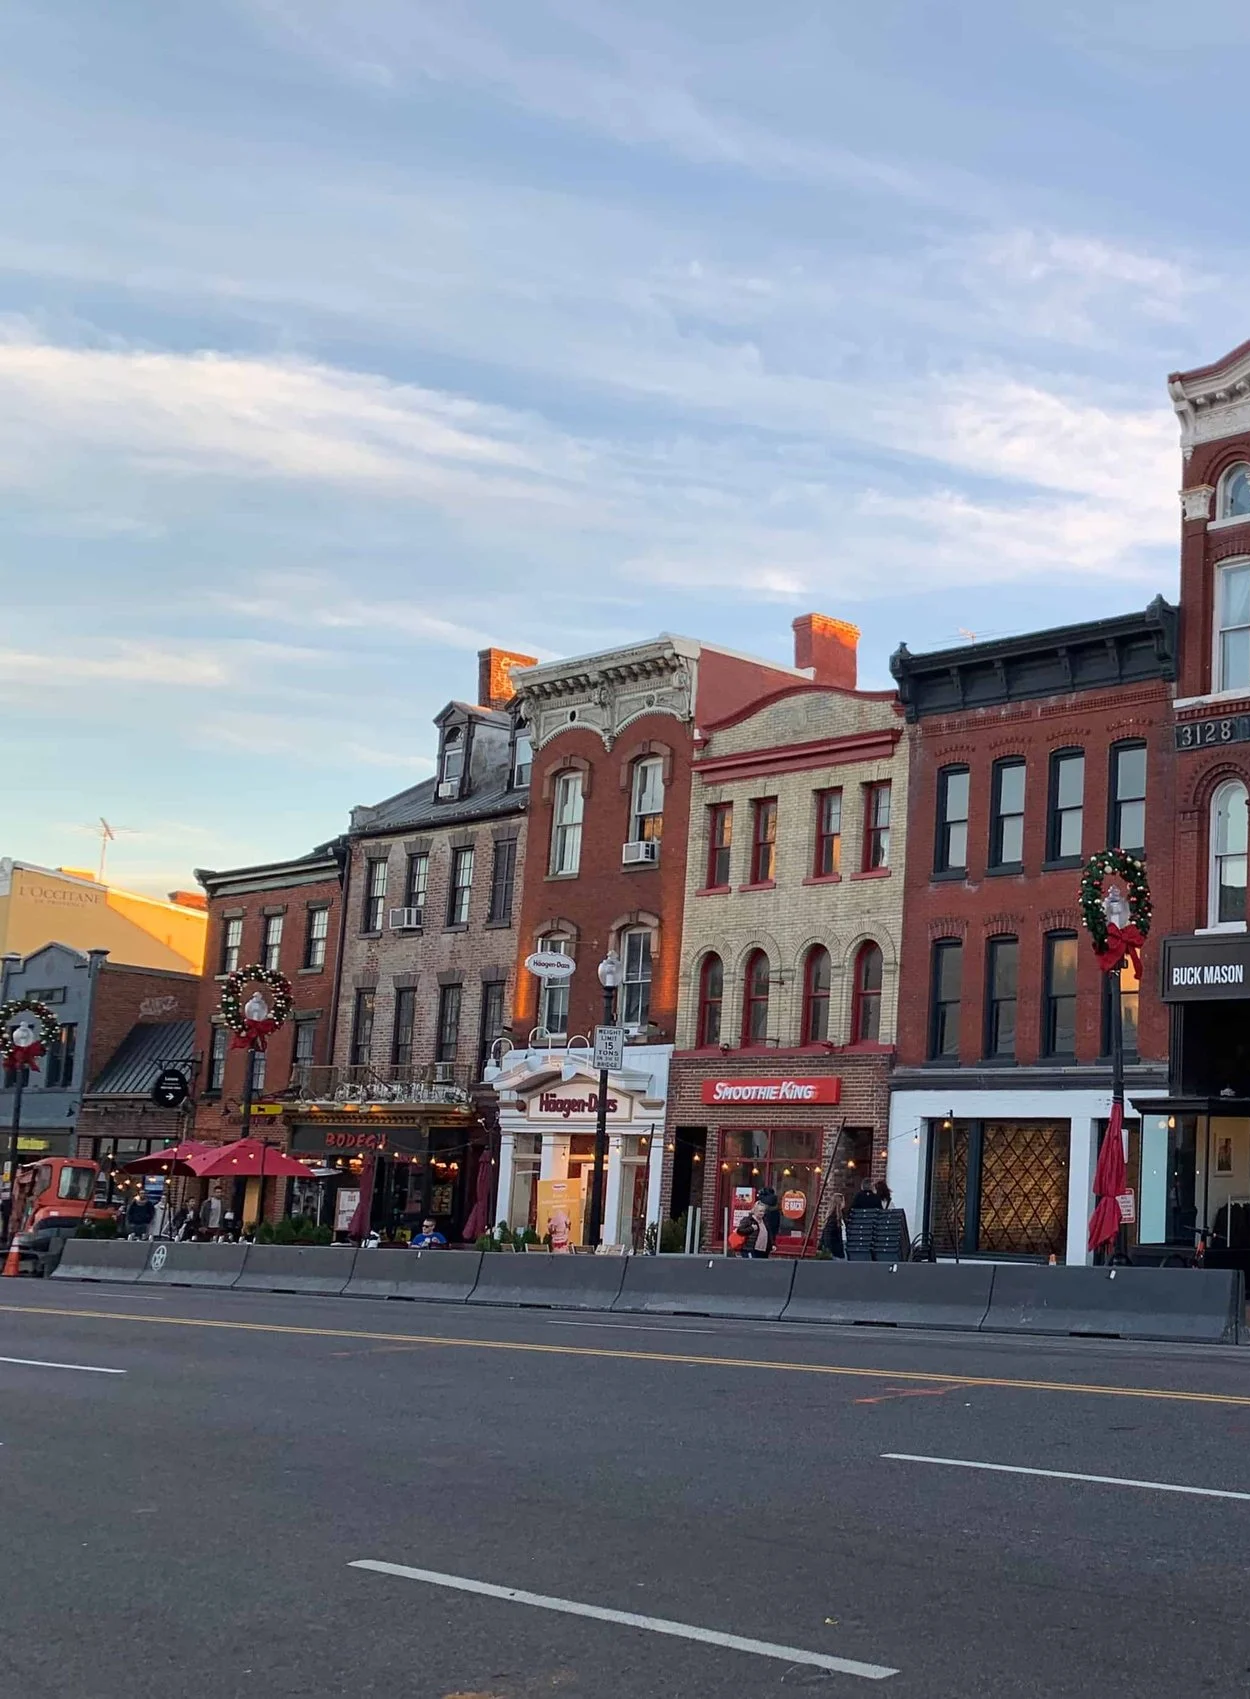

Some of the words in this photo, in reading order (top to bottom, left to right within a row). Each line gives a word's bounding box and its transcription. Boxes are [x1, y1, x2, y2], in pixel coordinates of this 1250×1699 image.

[1181, 720, 1232, 746] 3128
[533, 960, 570, 969] Häagen-Dazs
[1173, 966, 1202, 986] BUCK
[1203, 964, 1244, 984] MASON
[604, 1041, 614, 1050] 15
[539, 1093, 618, 1118] Häagen-Dzs
